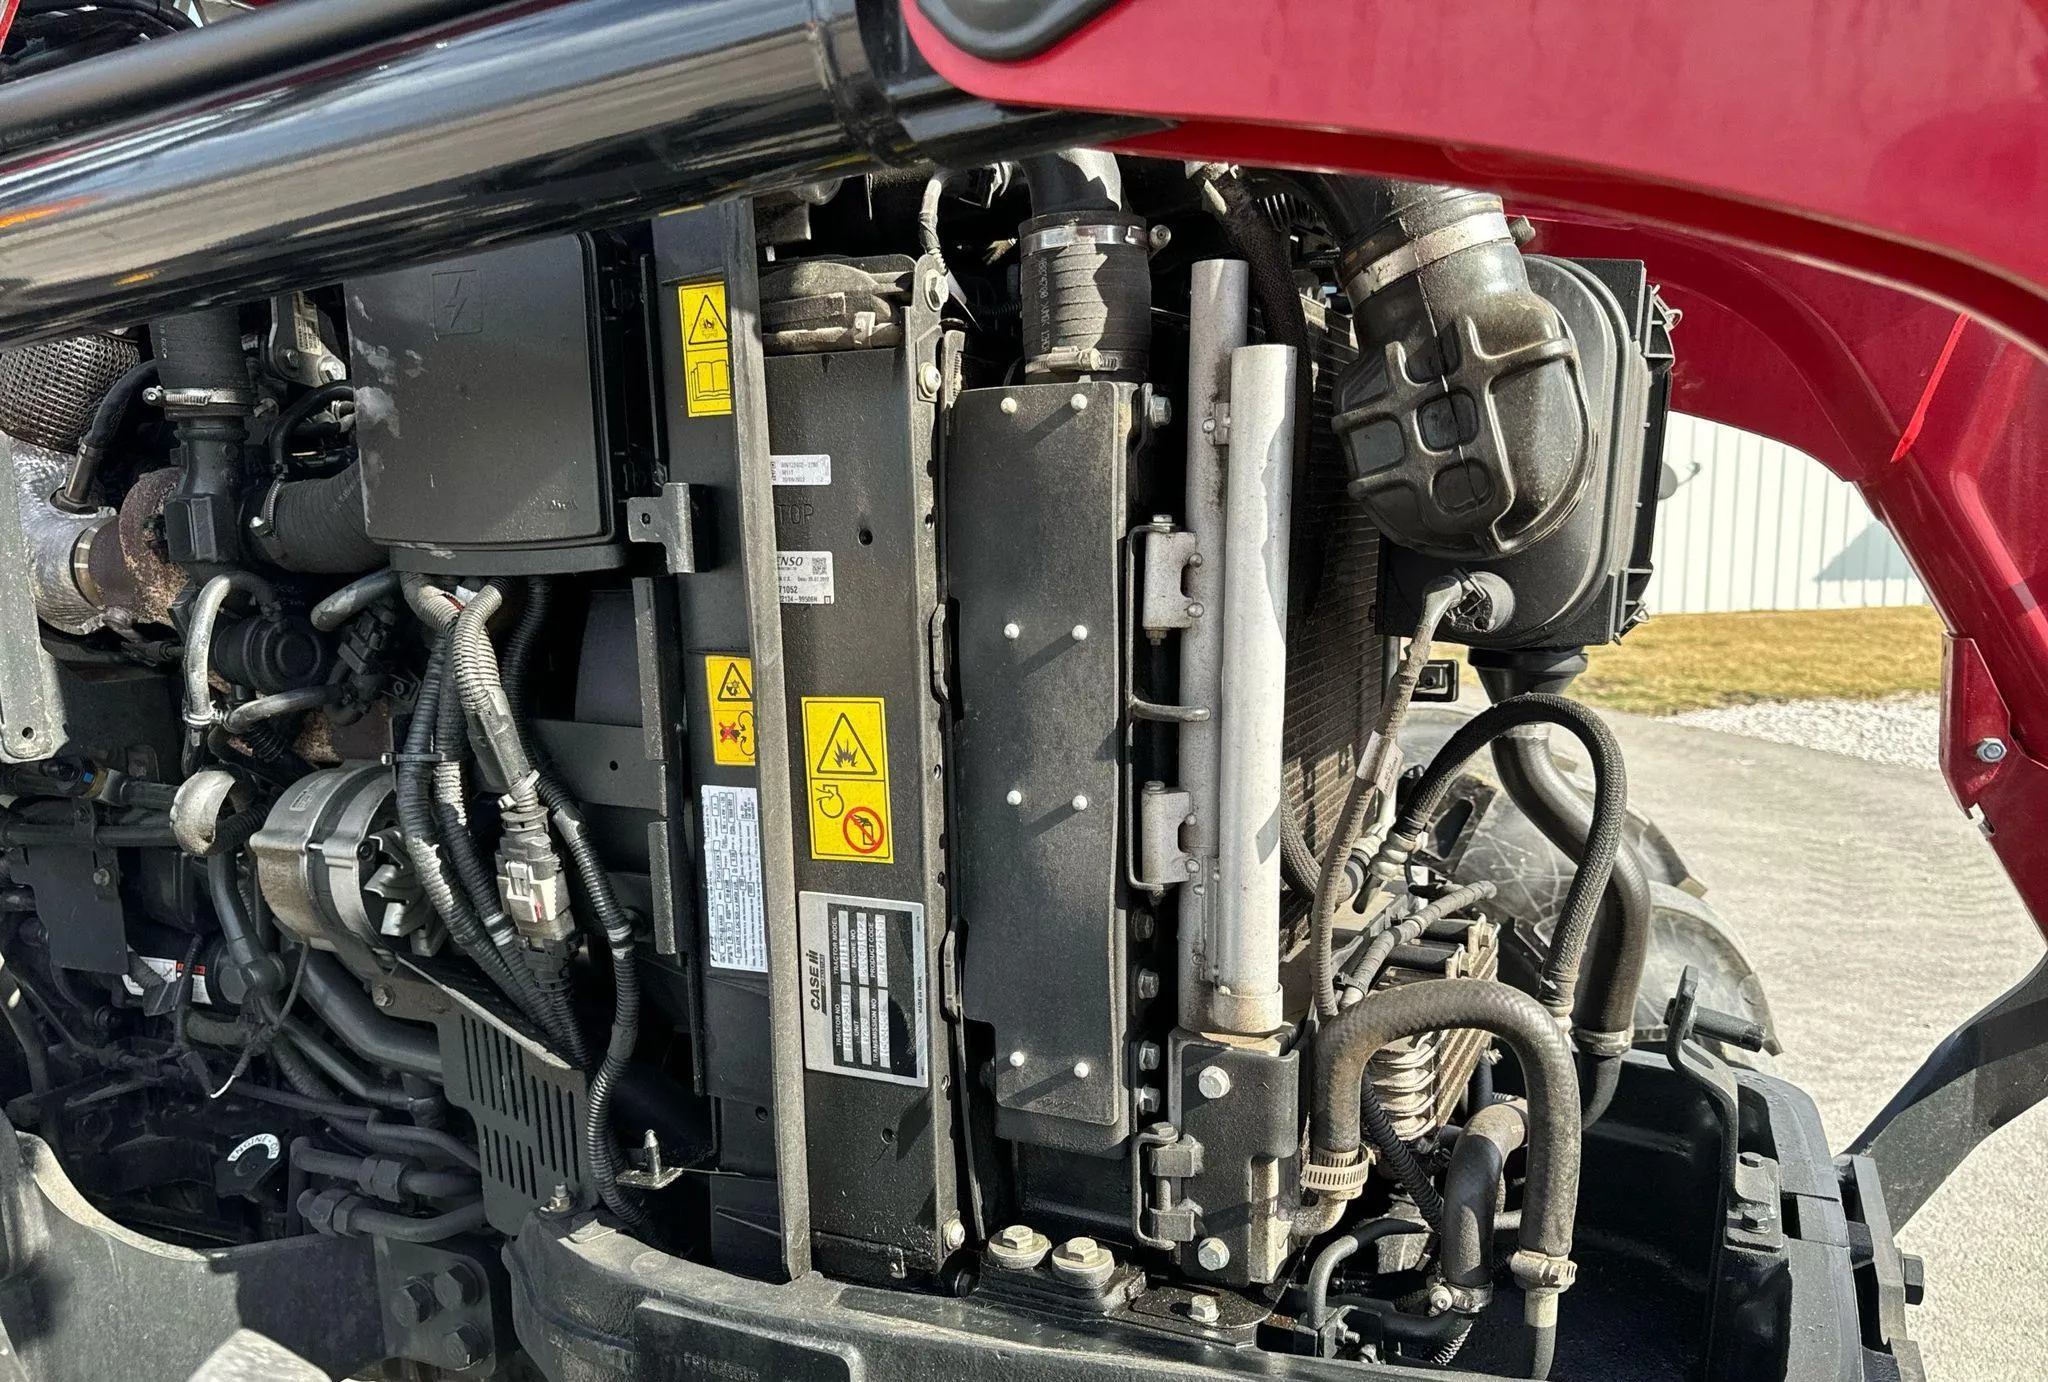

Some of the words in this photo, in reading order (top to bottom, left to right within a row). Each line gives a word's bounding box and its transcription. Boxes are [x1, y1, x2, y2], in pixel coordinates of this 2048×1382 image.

[850, 929, 856, 940] NO
[868, 944, 876, 978] PRODUCT
[809, 965, 820, 1011] CASE
[834, 1003, 841, 1014] NO
[870, 998, 877, 1009] NO
[871, 1010, 879, 1062] TRANSMISSION
[230, 1135, 269, 1159] ENGINE
